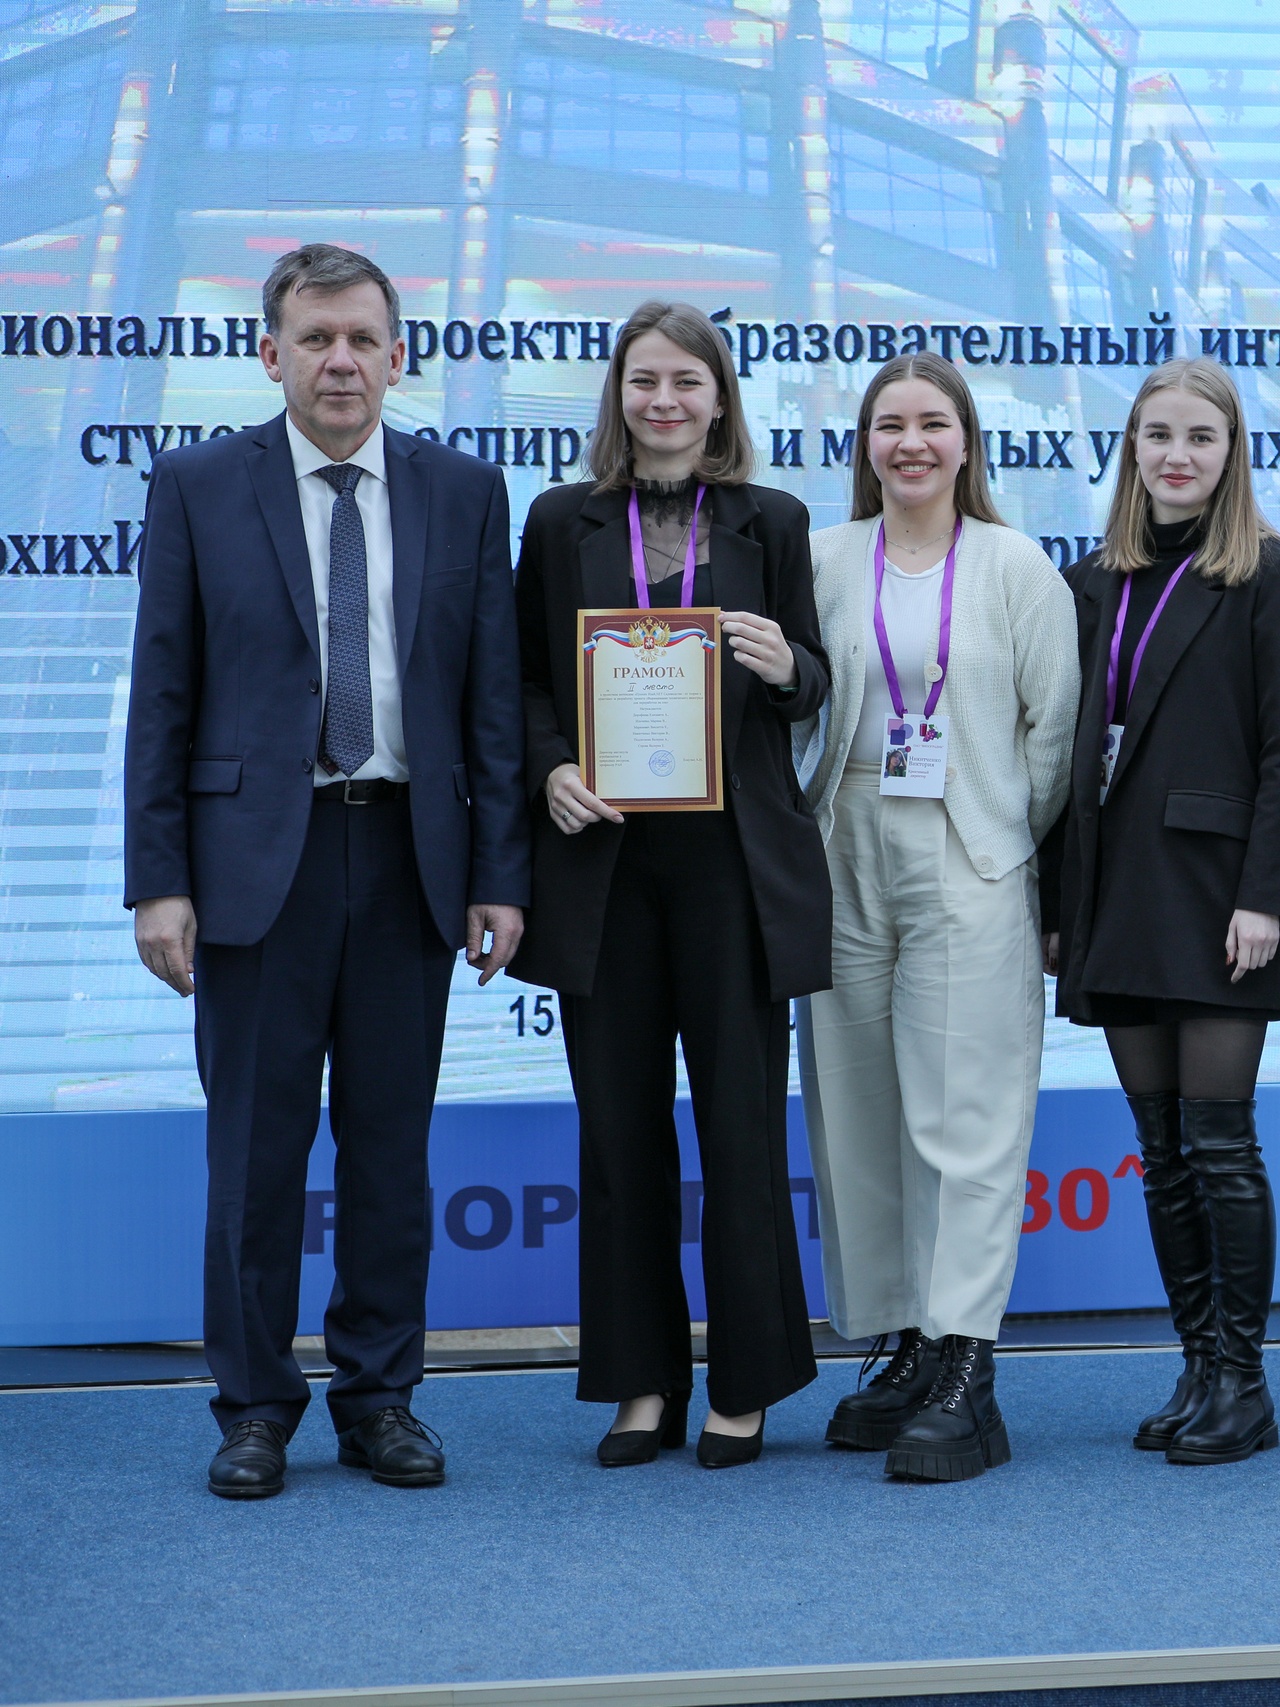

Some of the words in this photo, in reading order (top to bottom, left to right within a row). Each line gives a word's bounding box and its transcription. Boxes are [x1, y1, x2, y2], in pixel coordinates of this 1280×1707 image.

[0, 313, 268, 359] иональн
[768, 428, 804, 468] и
[613, 667, 685, 678] ГРАМОТА
[509, 994, 555, 1037] 15
